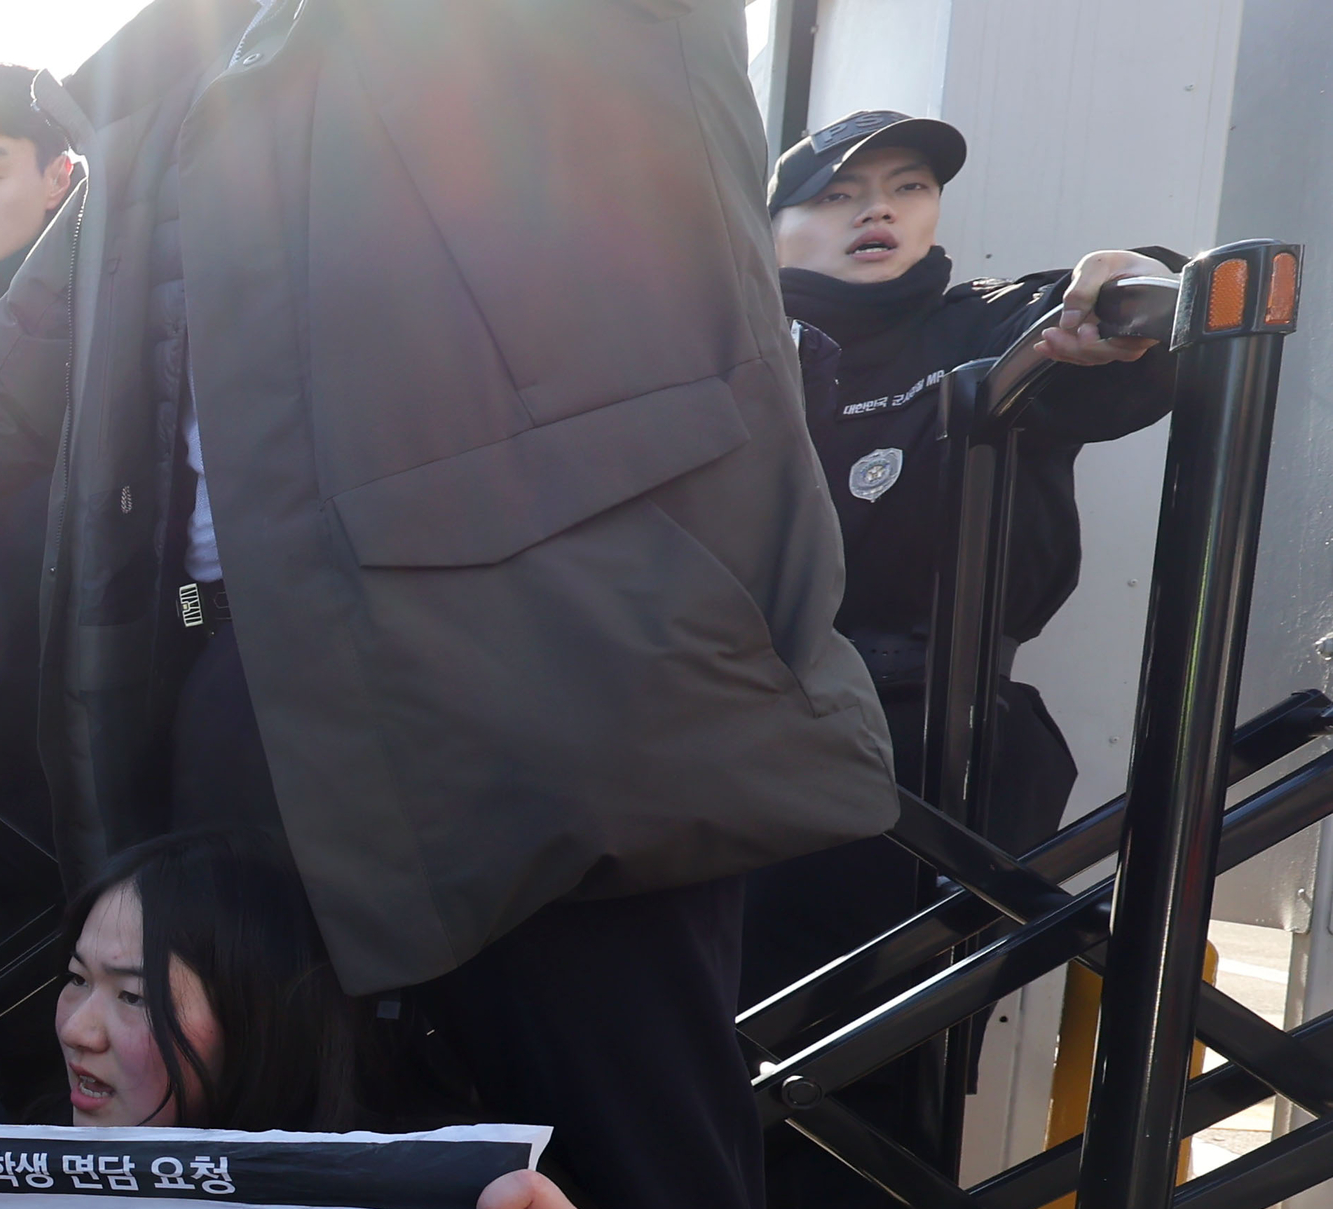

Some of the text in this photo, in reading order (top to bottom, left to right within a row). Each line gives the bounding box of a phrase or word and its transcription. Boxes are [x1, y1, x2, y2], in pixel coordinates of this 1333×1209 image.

[926, 369, 945, 387] MP
[62, 1154, 140, 1192] 면담
[150, 1154, 237, 1195] 요청
